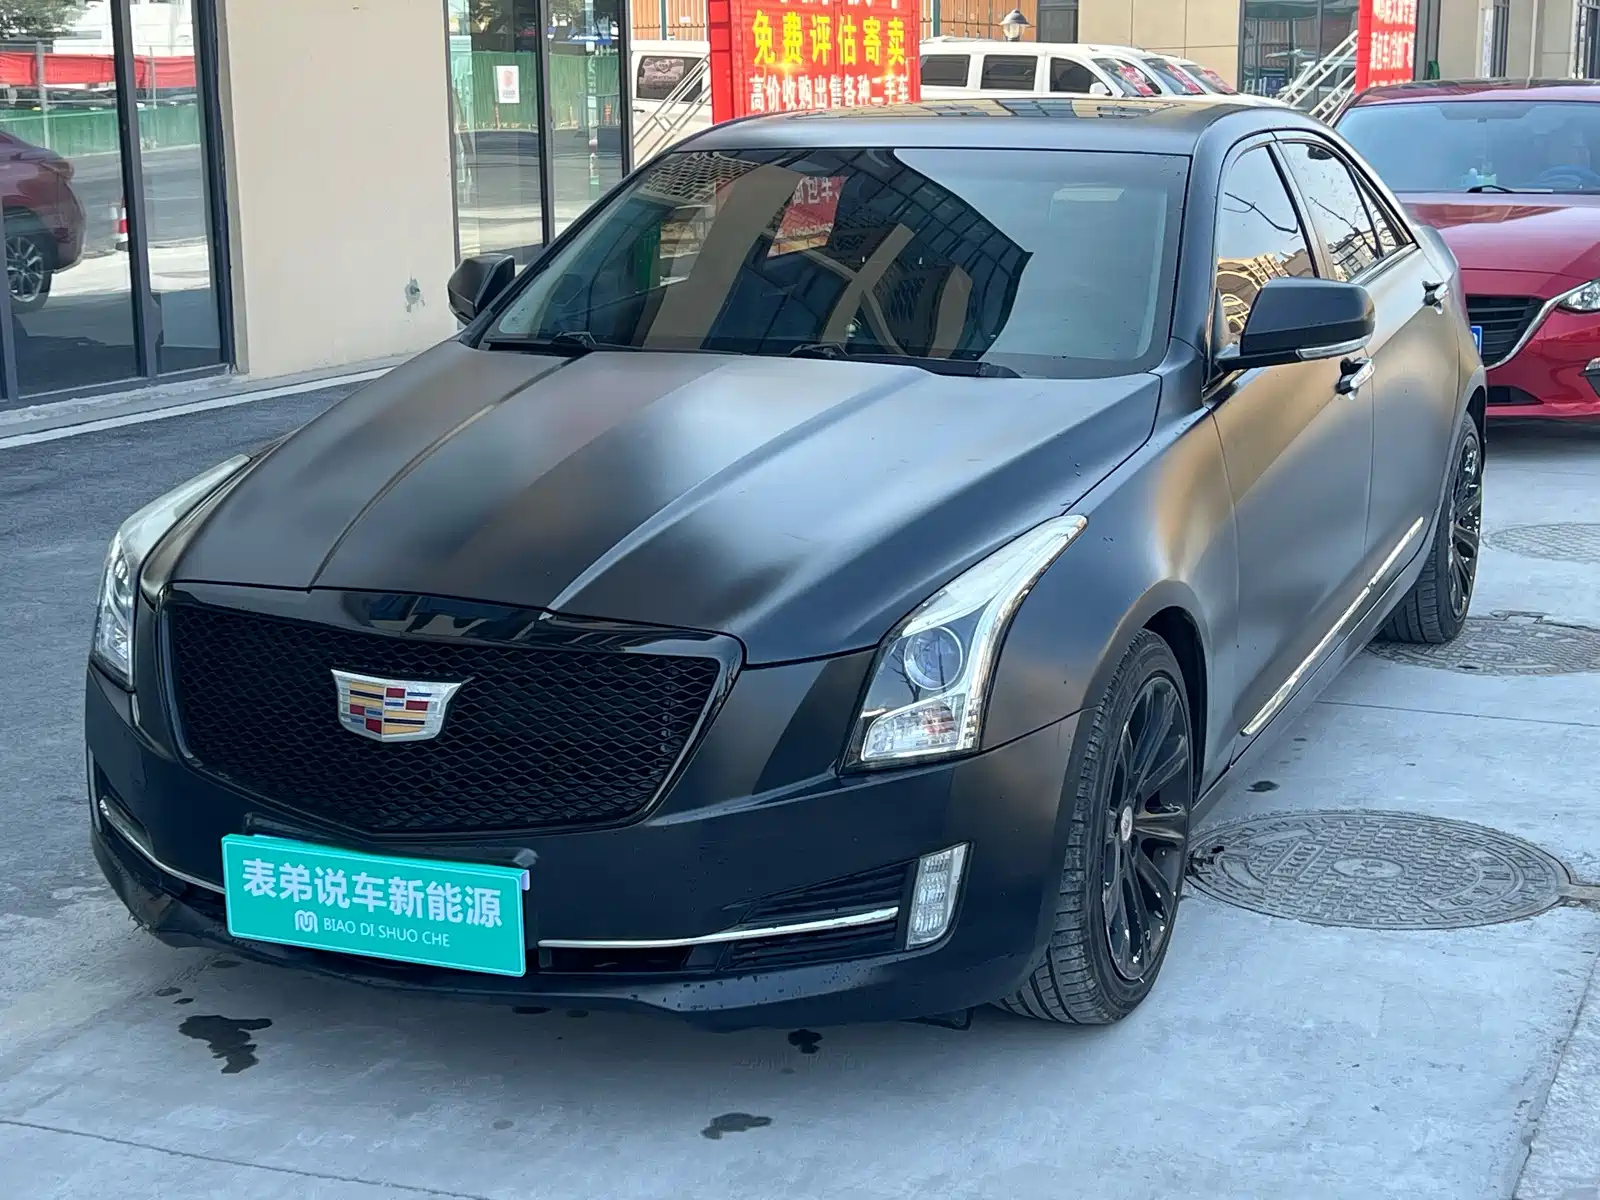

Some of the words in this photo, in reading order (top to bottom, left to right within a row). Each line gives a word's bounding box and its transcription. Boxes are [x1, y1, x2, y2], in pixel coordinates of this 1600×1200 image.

[752, 9, 905, 66] 免费评估寄卖
[749, 72, 909, 112] 高价收购出售各种二手车
[242, 858, 503, 928] 表弟说车新能源
[324, 917, 356, 934] BIAO
[360, 923, 375, 937] DI
[379, 925, 418, 943] SHUO
[422, 929, 450, 947] CHE
